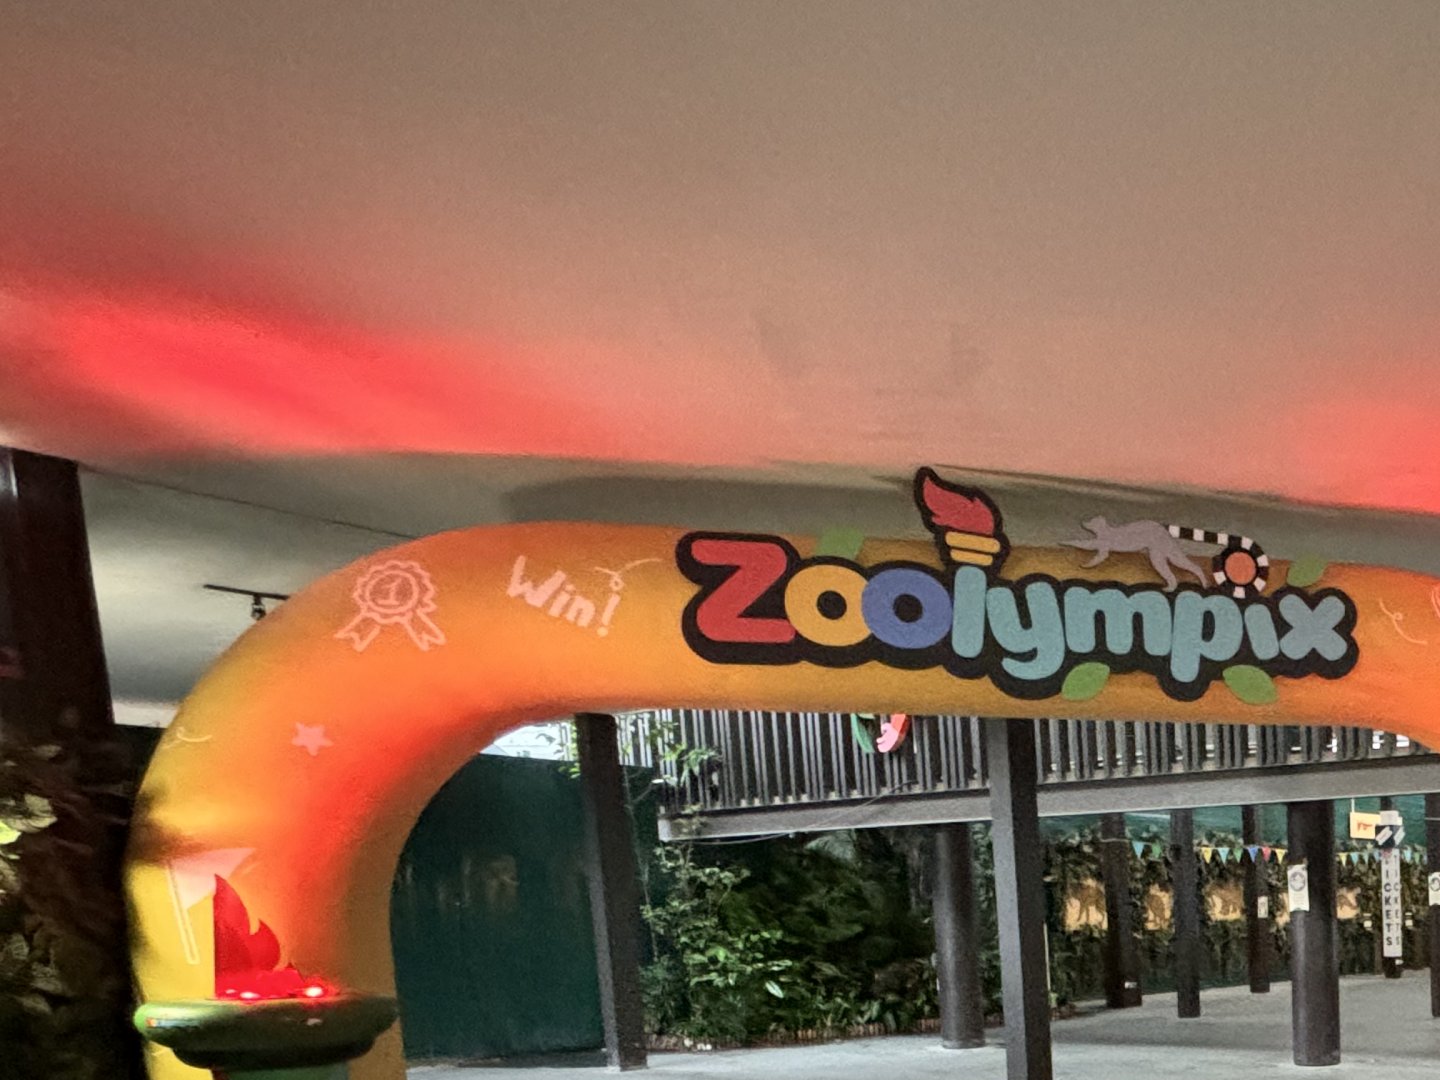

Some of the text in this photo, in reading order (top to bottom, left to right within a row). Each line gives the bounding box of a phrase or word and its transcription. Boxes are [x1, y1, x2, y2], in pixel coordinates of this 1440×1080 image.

[376, 578, 401, 606] 1
[507, 555, 620, 637] Win!
[691, 540, 1347, 682] Zoolympix
